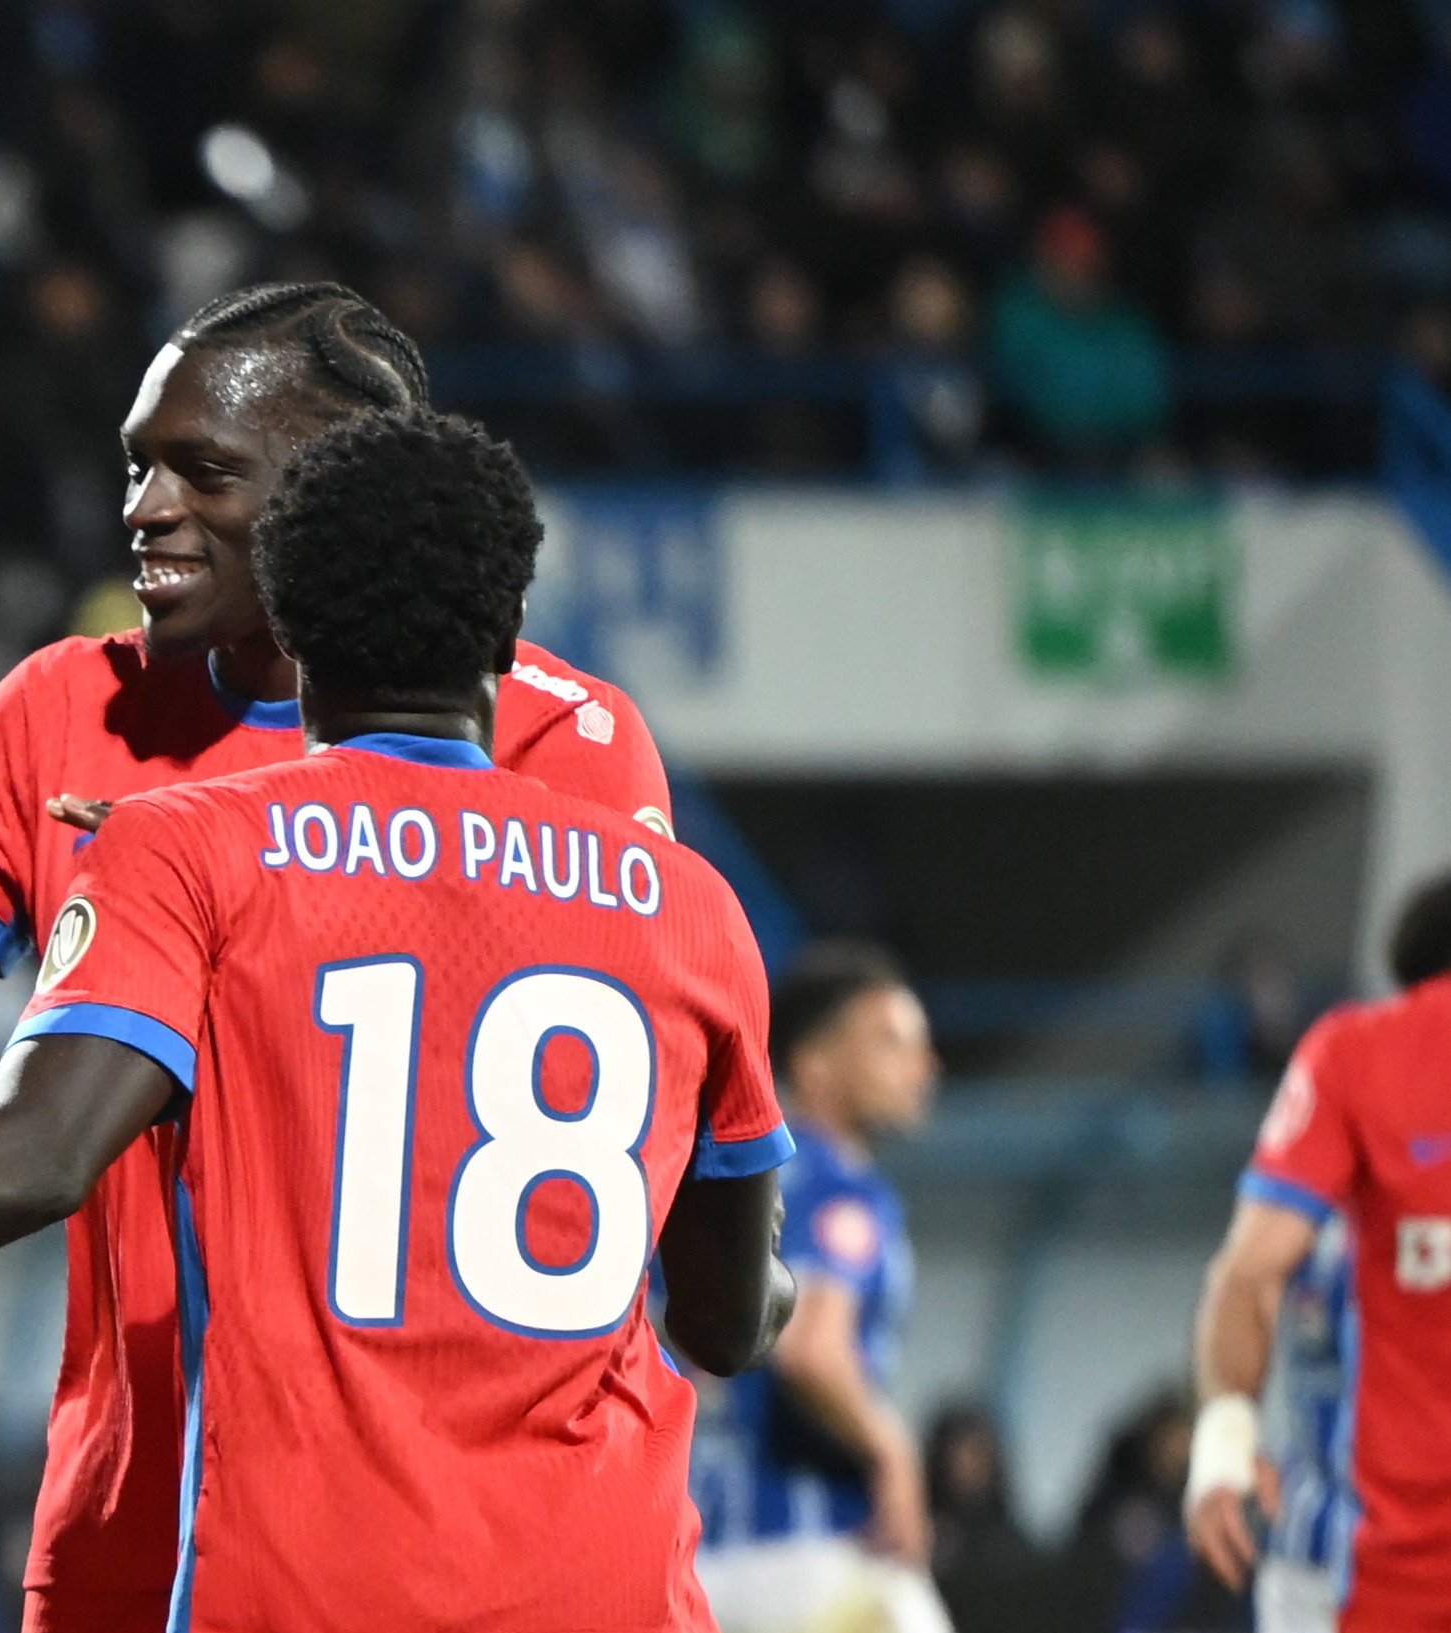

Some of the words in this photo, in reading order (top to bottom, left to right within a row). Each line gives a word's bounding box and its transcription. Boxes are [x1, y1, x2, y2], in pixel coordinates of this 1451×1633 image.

[262, 803, 438, 882] JOAO
[458, 810, 662, 918] PAULO
[314, 953, 656, 1341] 18
